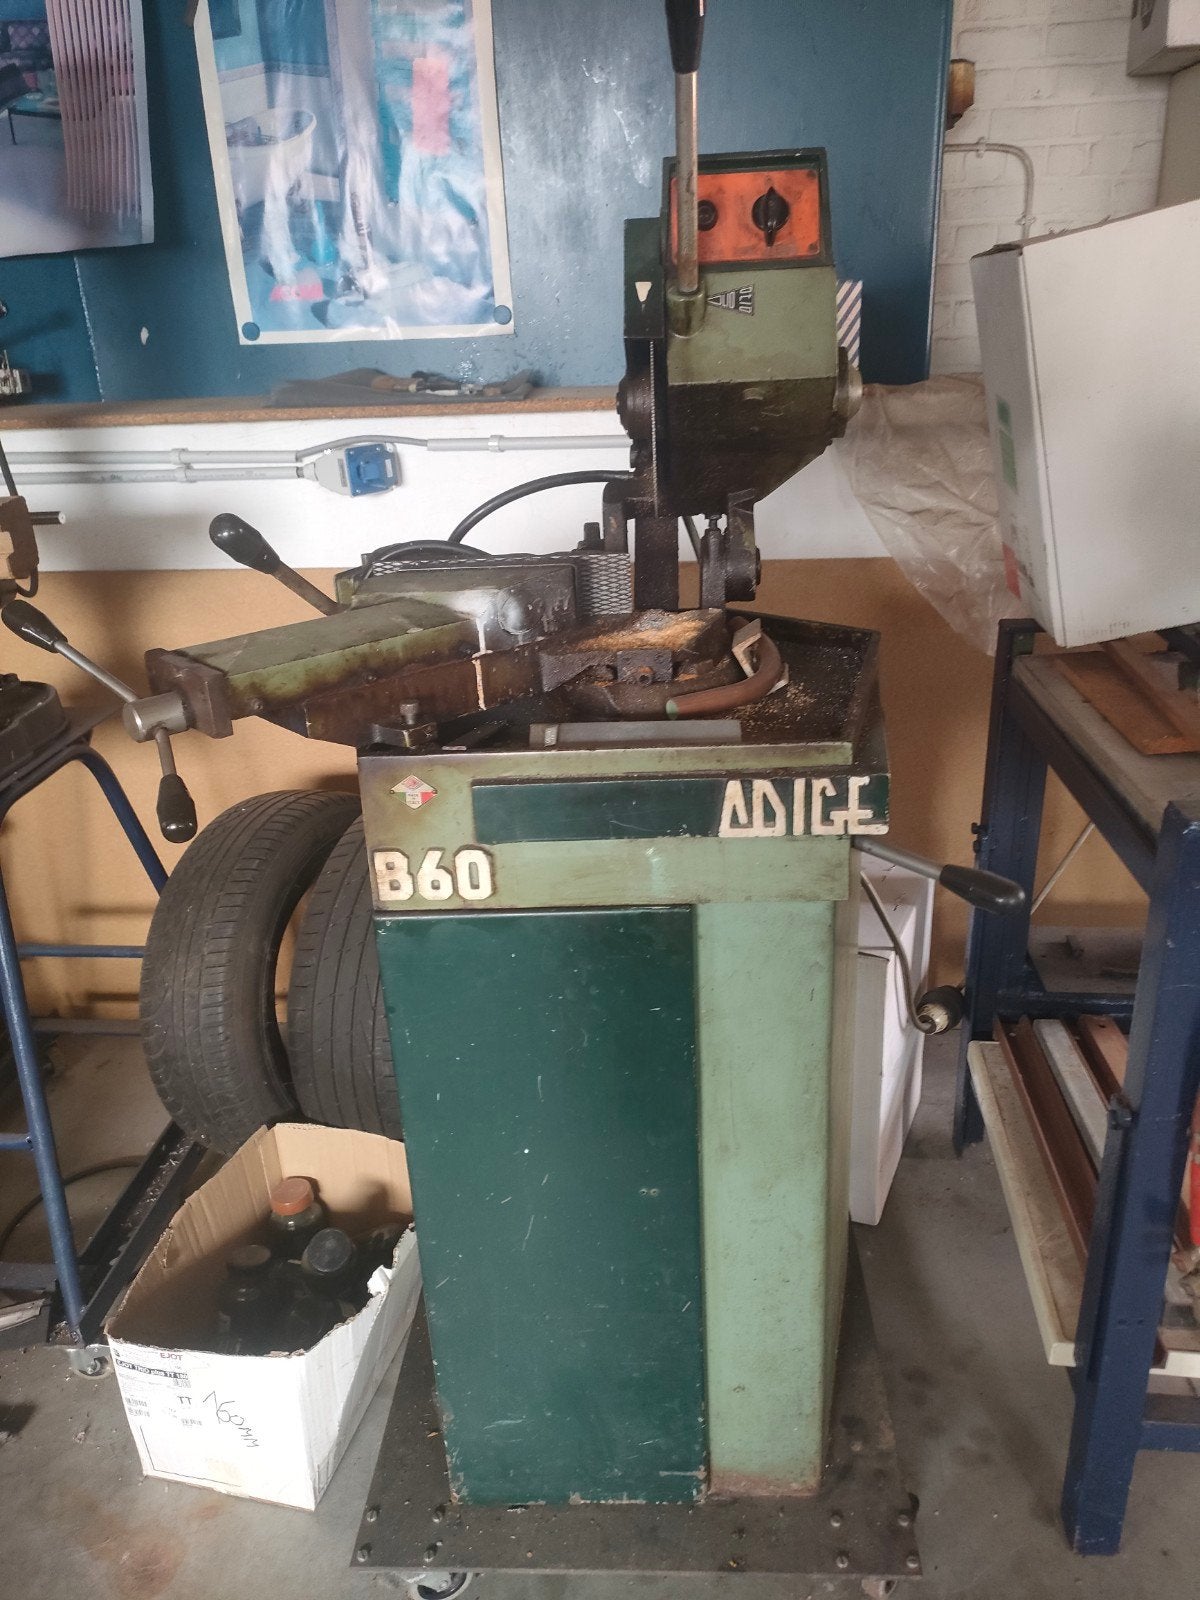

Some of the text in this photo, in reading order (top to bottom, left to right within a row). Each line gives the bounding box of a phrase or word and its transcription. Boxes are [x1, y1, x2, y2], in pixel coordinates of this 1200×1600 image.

[718, 776, 889, 837] ADIGE
[374, 850, 493, 901] B60
[160, 1352, 183, 1361] EJOT
